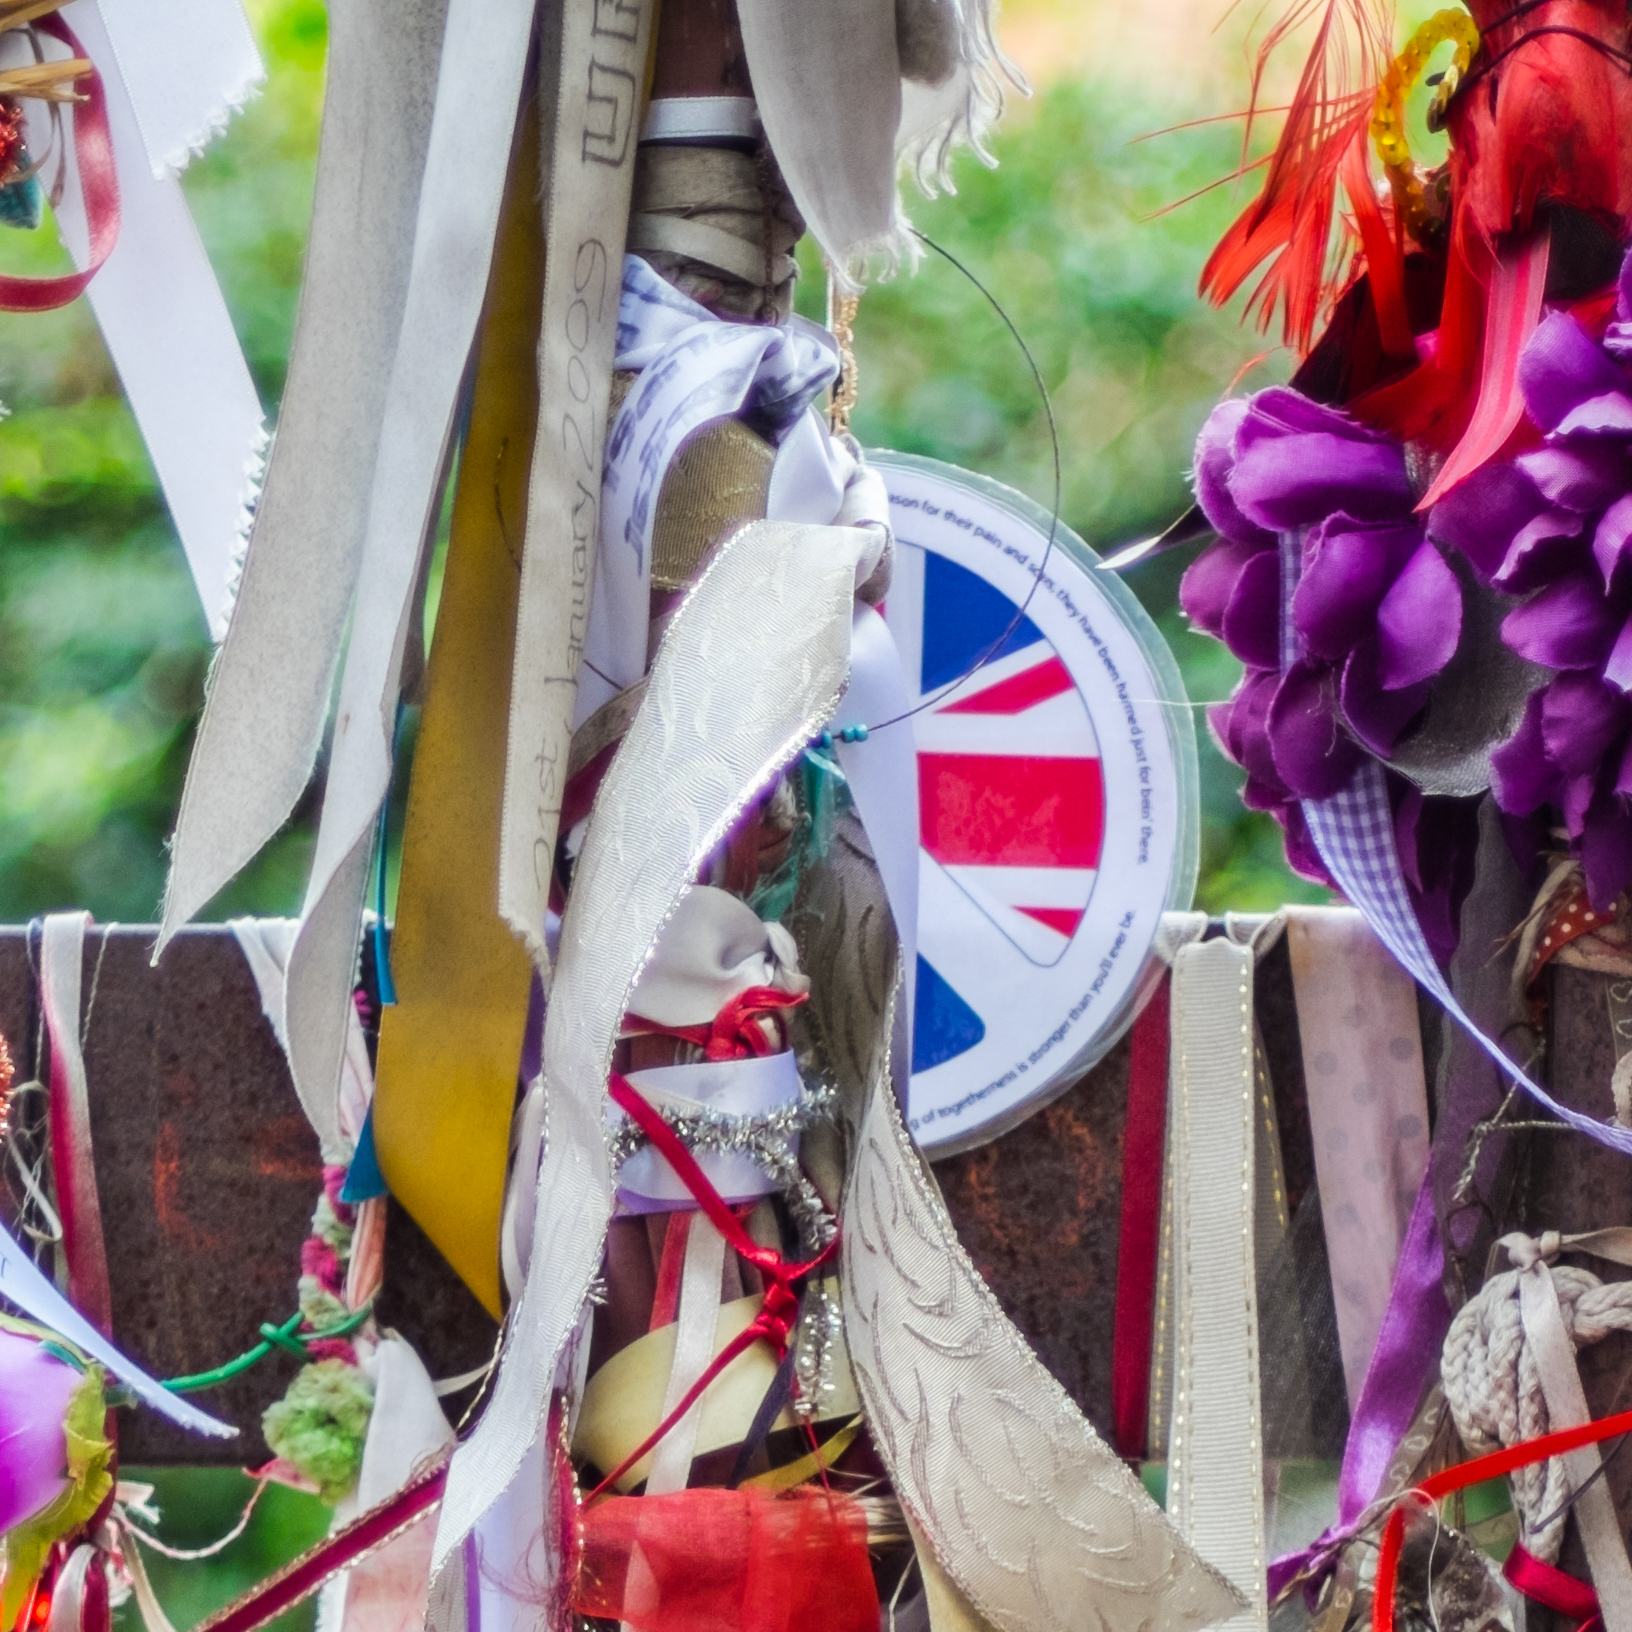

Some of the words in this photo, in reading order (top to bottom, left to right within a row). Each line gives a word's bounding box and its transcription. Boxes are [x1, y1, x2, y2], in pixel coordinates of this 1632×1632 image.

[561, 238, 610, 474] 2009
[944, 509, 972, 531] their
[972, 524, 1003, 549] pain
[1003, 545, 1030, 566] and
[1056, 587, 1081, 619] they
[1078, 614, 1103, 648] have
[1097, 645, 1119, 683] been
[1116, 681, 1143, 736] harmed
[1130, 734, 1148, 763] just
[1138, 764, 1152, 786] for
